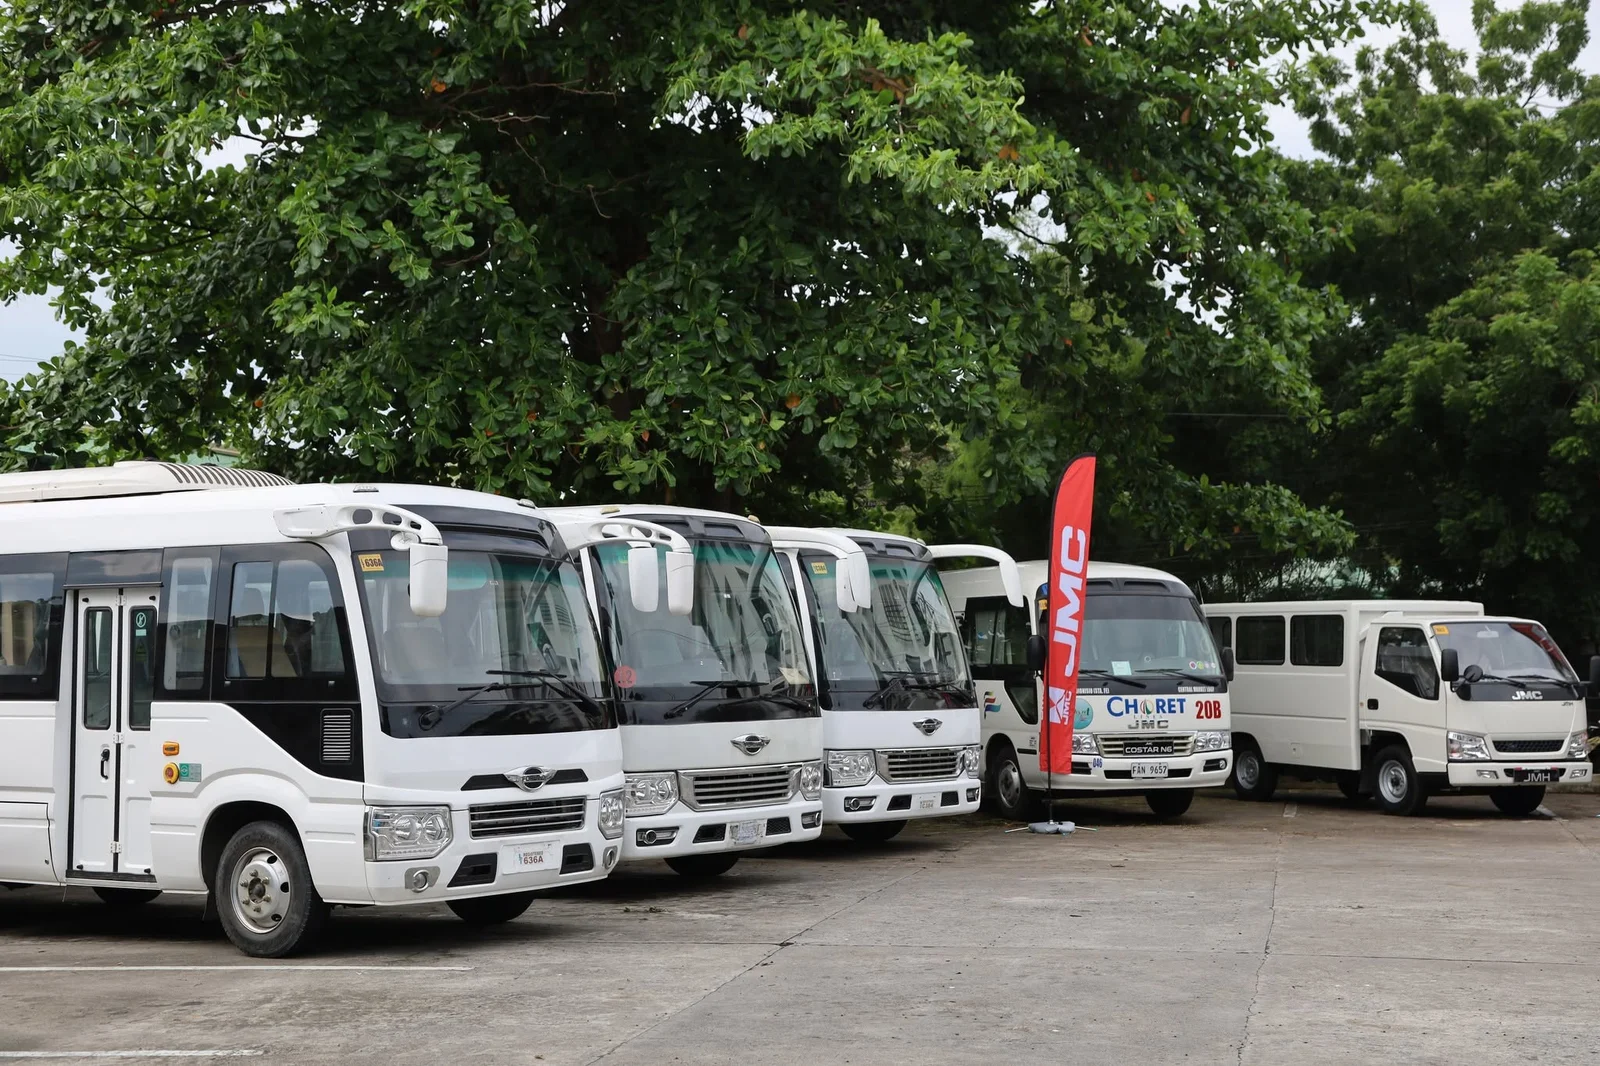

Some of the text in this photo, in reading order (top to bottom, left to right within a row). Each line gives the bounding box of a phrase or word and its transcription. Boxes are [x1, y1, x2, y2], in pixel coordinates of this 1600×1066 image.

[1053, 525, 1086, 677] JMC
[1511, 690, 1543, 700] JMC
[1061, 690, 1072, 725] JMC
[1195, 700, 1222, 719] 20B
[1128, 720, 1169, 729] JMC
[1132, 765, 1167, 774] FAN 9657
[1523, 773, 1550, 782] JMH
[523, 855, 544, 865] 636A
